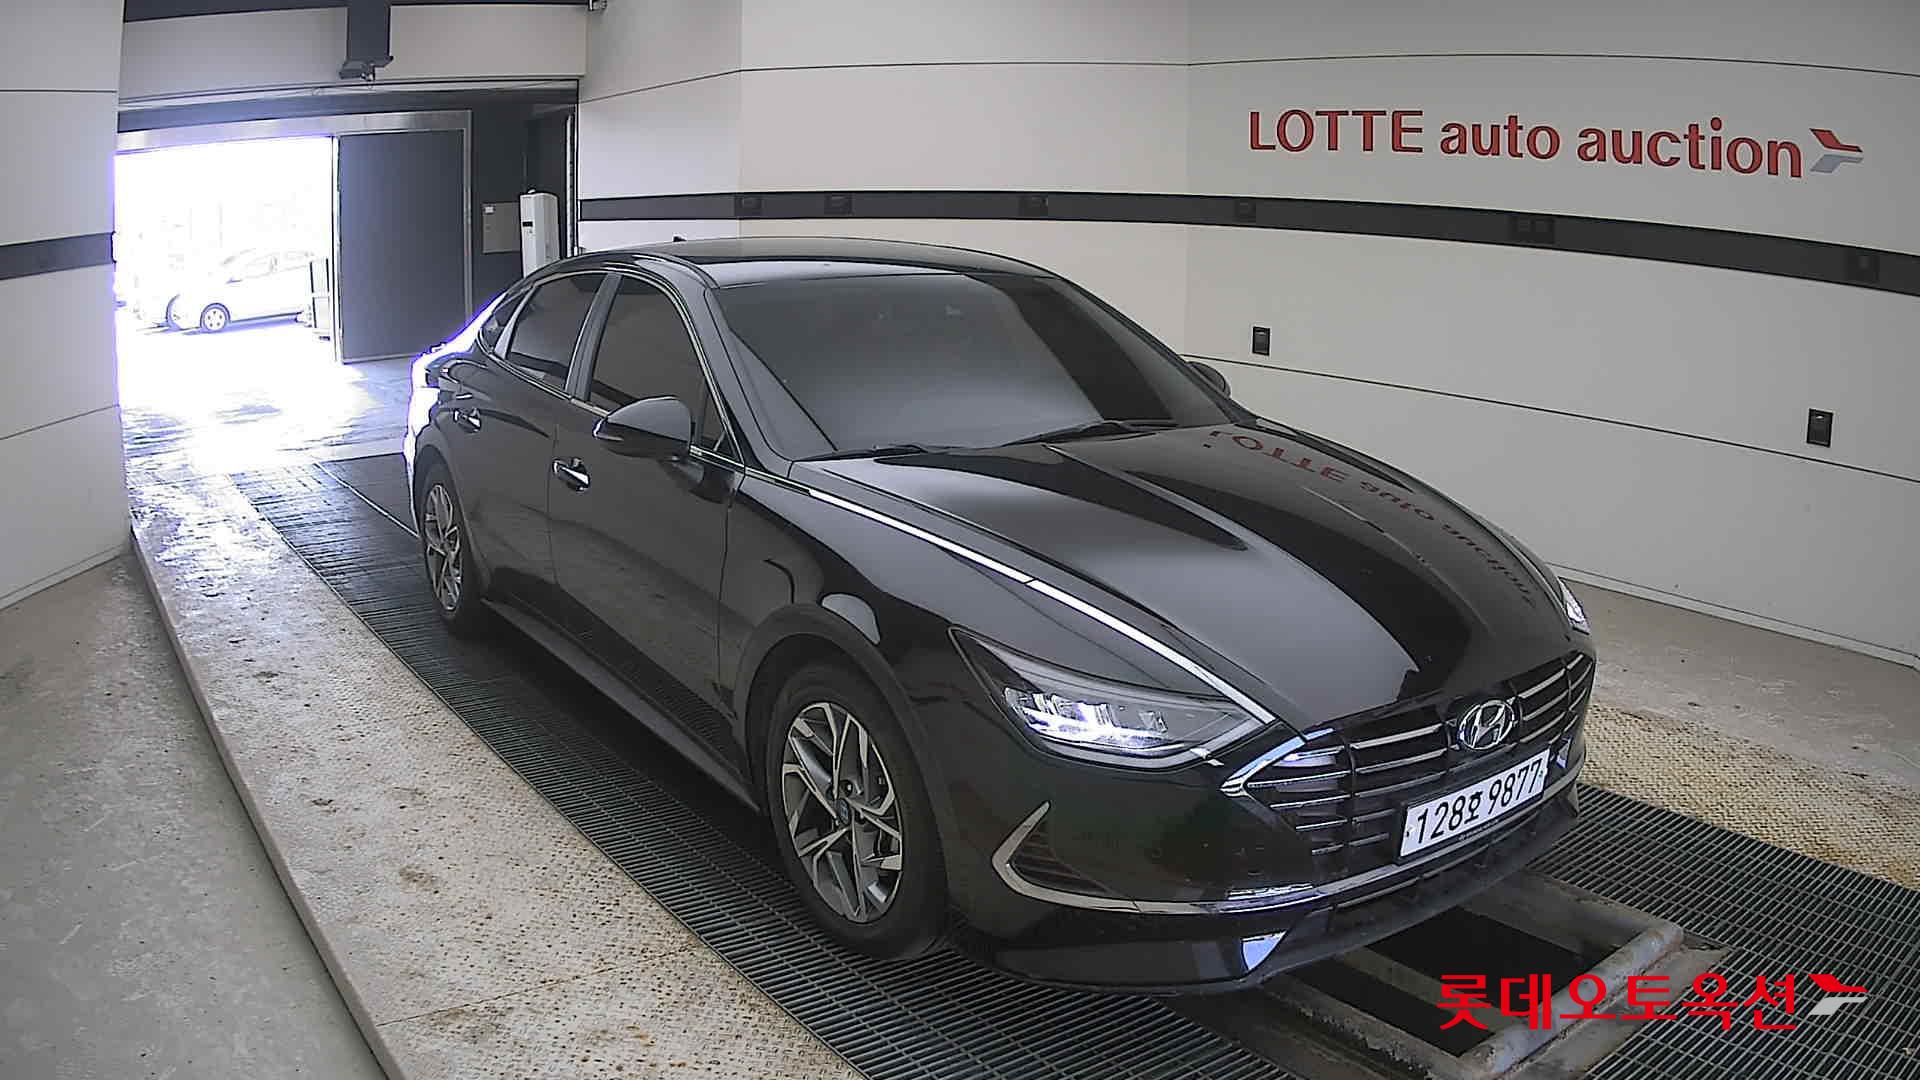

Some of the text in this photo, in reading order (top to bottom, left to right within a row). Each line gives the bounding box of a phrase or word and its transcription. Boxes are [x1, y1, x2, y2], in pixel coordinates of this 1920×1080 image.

[1249, 109, 1802, 178] LOTTE auto auction
[1417, 790, 1483, 844] 128호
[1488, 758, 1543, 815] 9877
